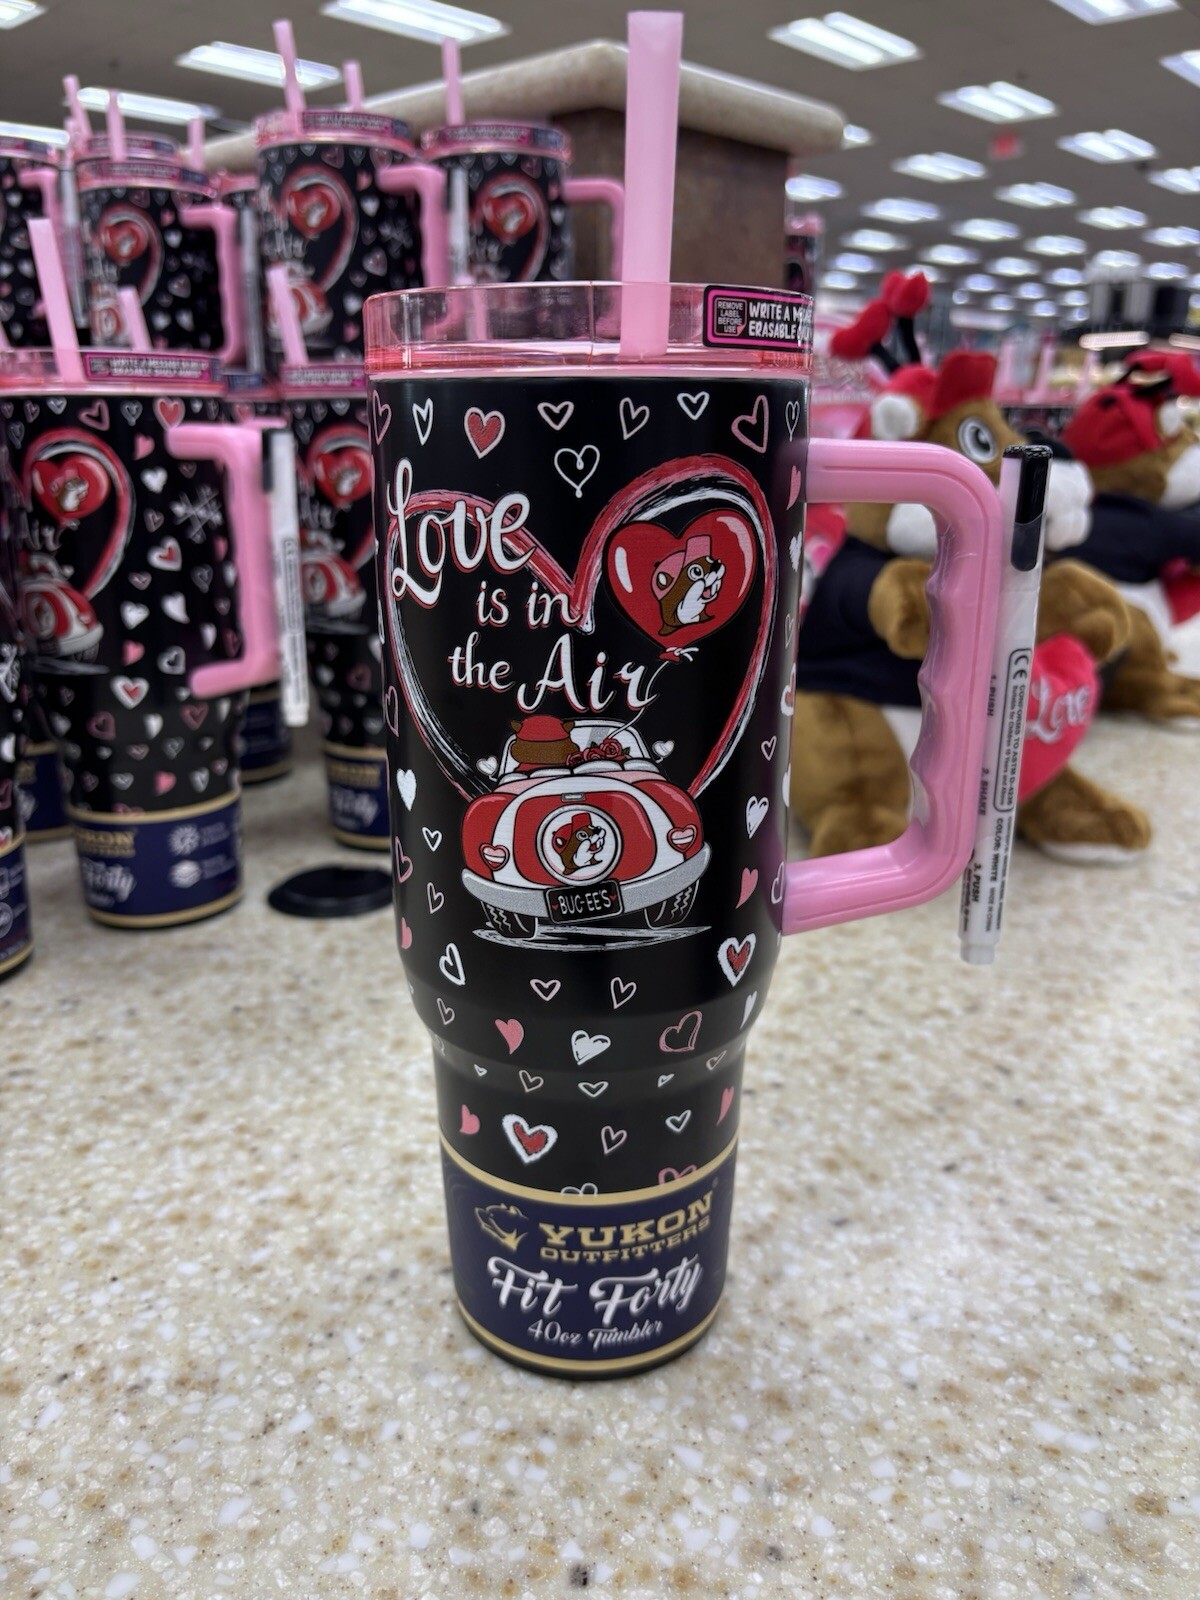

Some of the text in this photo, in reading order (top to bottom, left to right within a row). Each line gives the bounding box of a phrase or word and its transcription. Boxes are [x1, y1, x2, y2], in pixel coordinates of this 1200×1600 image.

[718, 301, 744, 311] REMOVE
[718, 317, 742, 325] BEFORE
[720, 309, 740, 318] LABEL
[749, 302, 782, 320] WRITE
[783, 306, 790, 321] A
[724, 325, 737, 334] USE
[748, 320, 797, 339] ERASABLE
[387, 458, 536, 608] Love
[476, 580, 582, 628] is in
[448, 631, 659, 714] the Air
[986, 686, 996, 716] PUSH
[1013, 684, 1026, 734] CONFORMS
[1005, 721, 1014, 746] Children
[1012, 738, 1019, 749] TO
[1009, 751, 1018, 774] ASTM
[977, 779, 988, 815] SHAKE
[989, 817, 1003, 882] COLOR: WHITE
[970, 862, 981, 902] 3. PUSH
[558, 889, 612, 915] BUC-EE'S
[538, 1191, 714, 1249] YUKON
[540, 1218, 711, 1263] OUTFITTERS
[487, 1254, 703, 1325] Fit Forty
[528, 1319, 663, 1350] 40oz Tumbler
